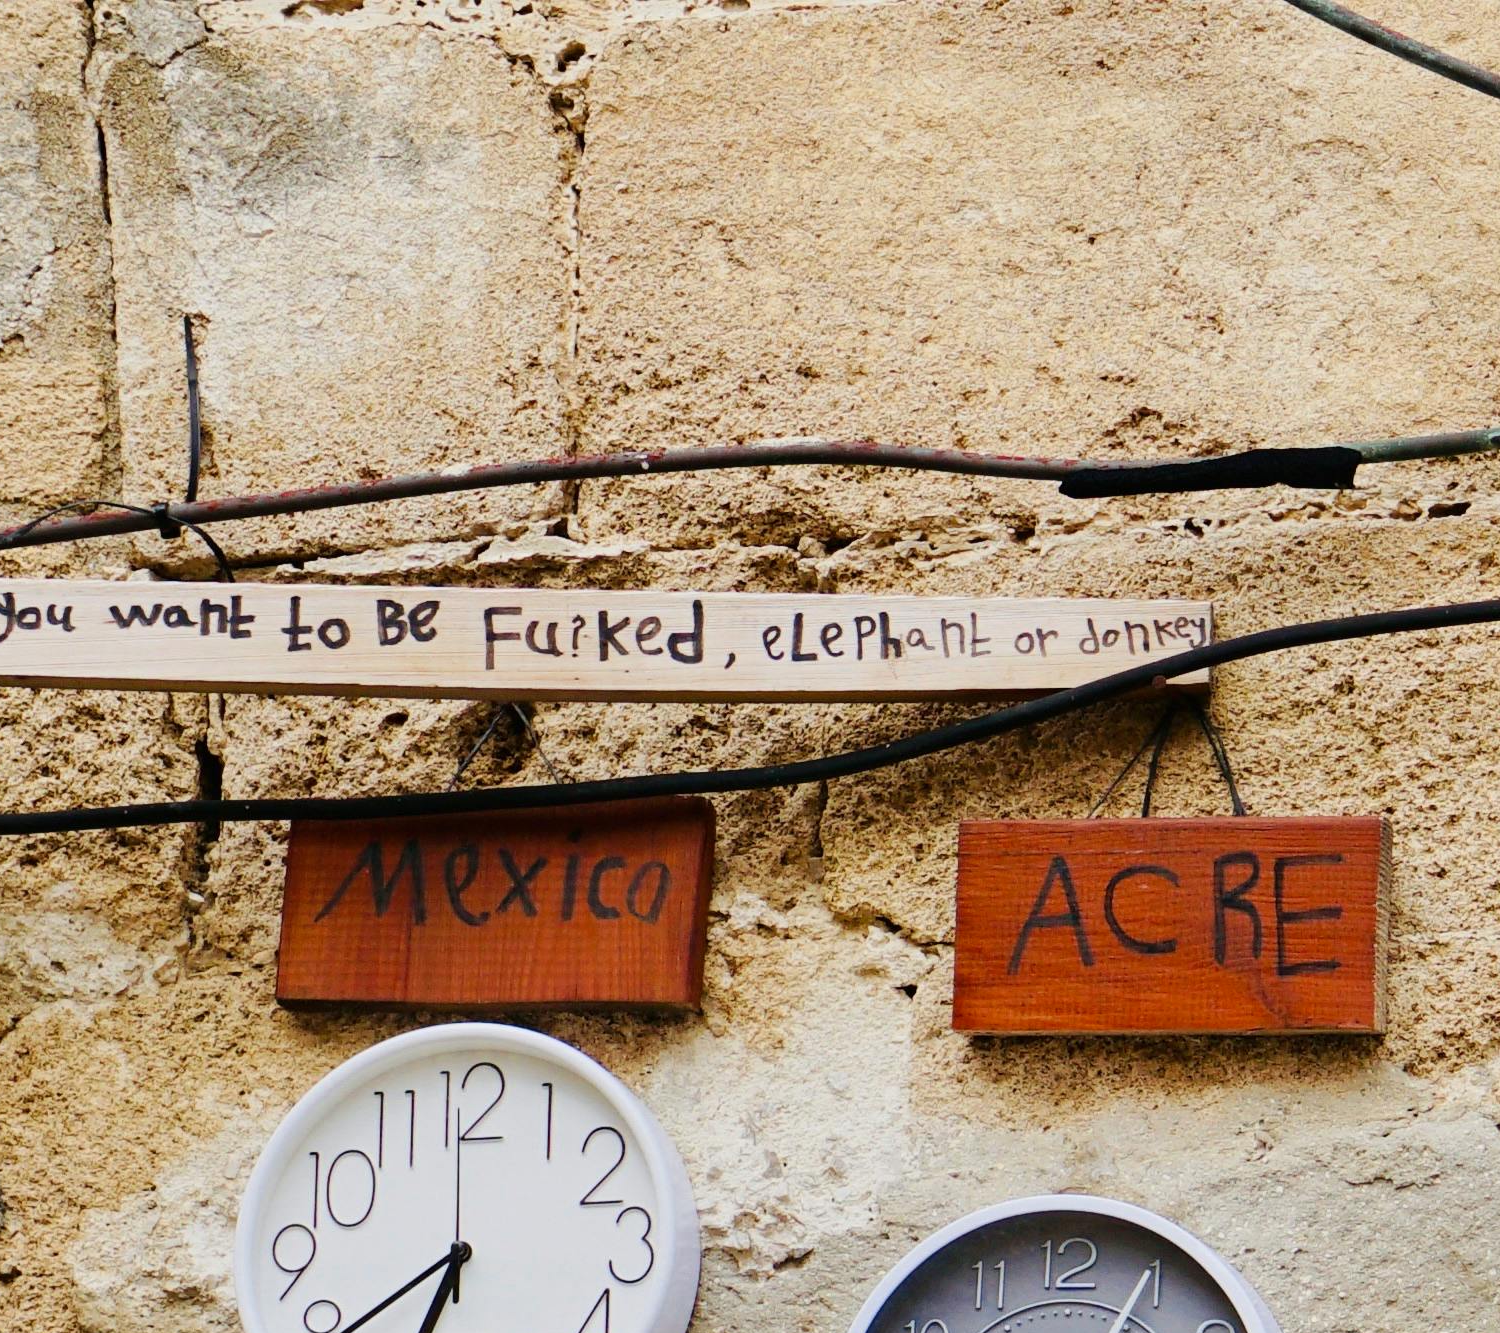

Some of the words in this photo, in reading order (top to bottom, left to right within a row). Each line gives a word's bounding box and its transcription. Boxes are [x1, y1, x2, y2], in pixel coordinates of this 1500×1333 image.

[110, 596, 256, 638] want
[282, 593, 347, 651] to
[1015, 631, 1065, 655] or
[1007, 852, 1343, 976] ACRE
